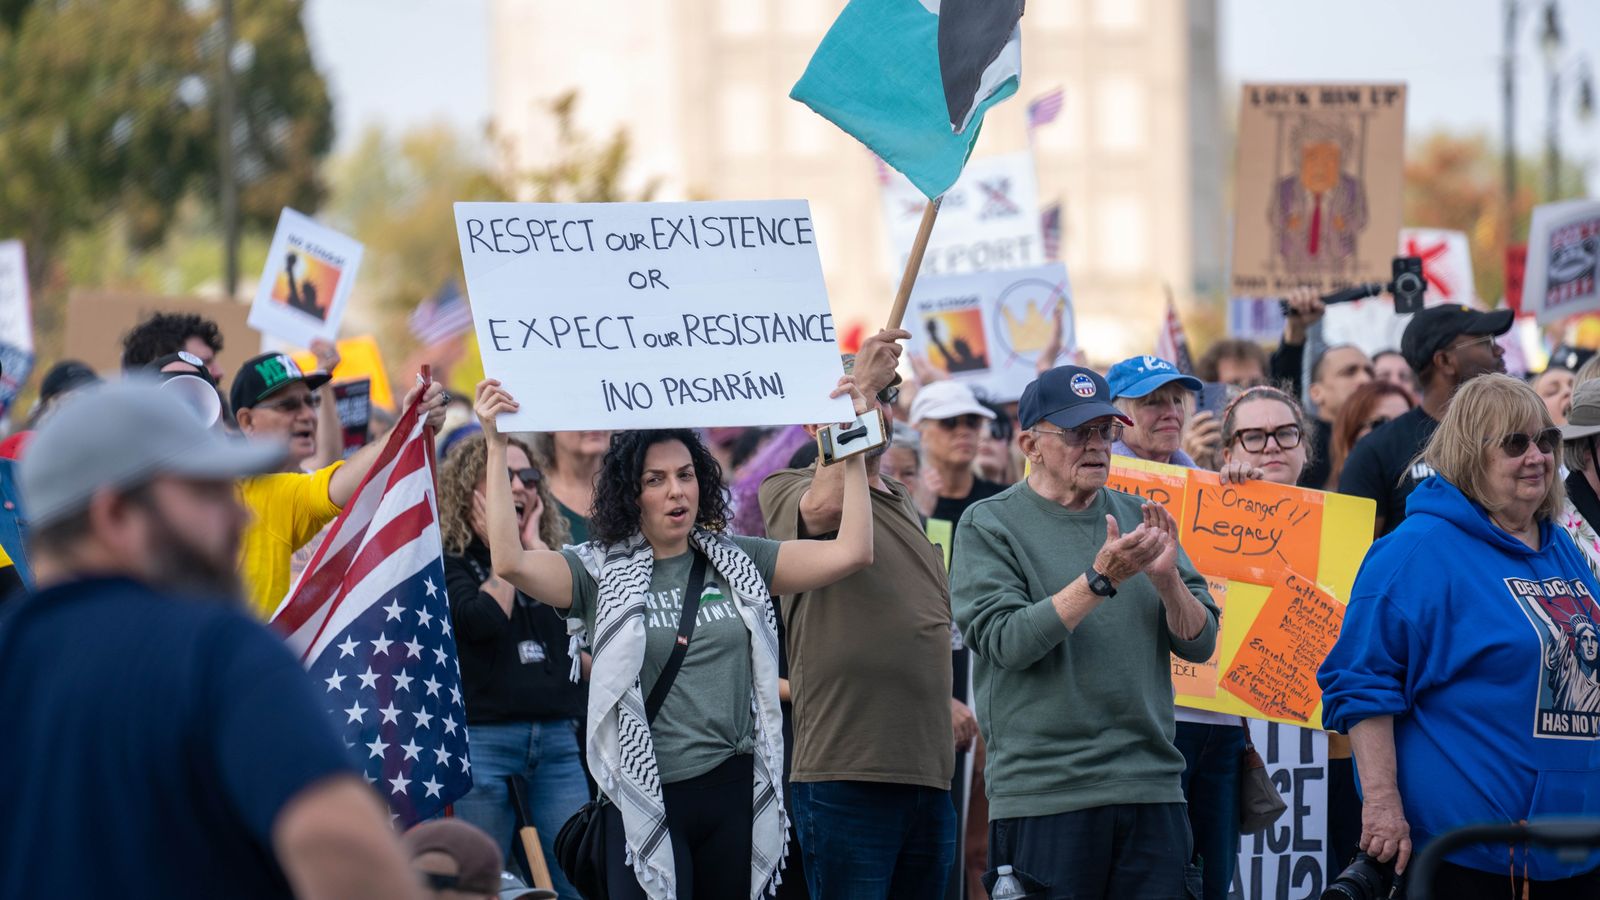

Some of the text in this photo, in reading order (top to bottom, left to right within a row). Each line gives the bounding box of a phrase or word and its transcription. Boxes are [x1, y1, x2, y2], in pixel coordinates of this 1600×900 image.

[467, 215, 812, 254] RESPECT OUR EXISTENCE
[628, 269, 669, 290] OR
[489, 313, 835, 352] EXPECT OUR RESISTANCE
[660, 370, 785, 406] PASARÁN!
[644, 588, 682, 610] REE
[1542, 712, 1569, 732] HAS
[1571, 714, 1589, 733] NO
